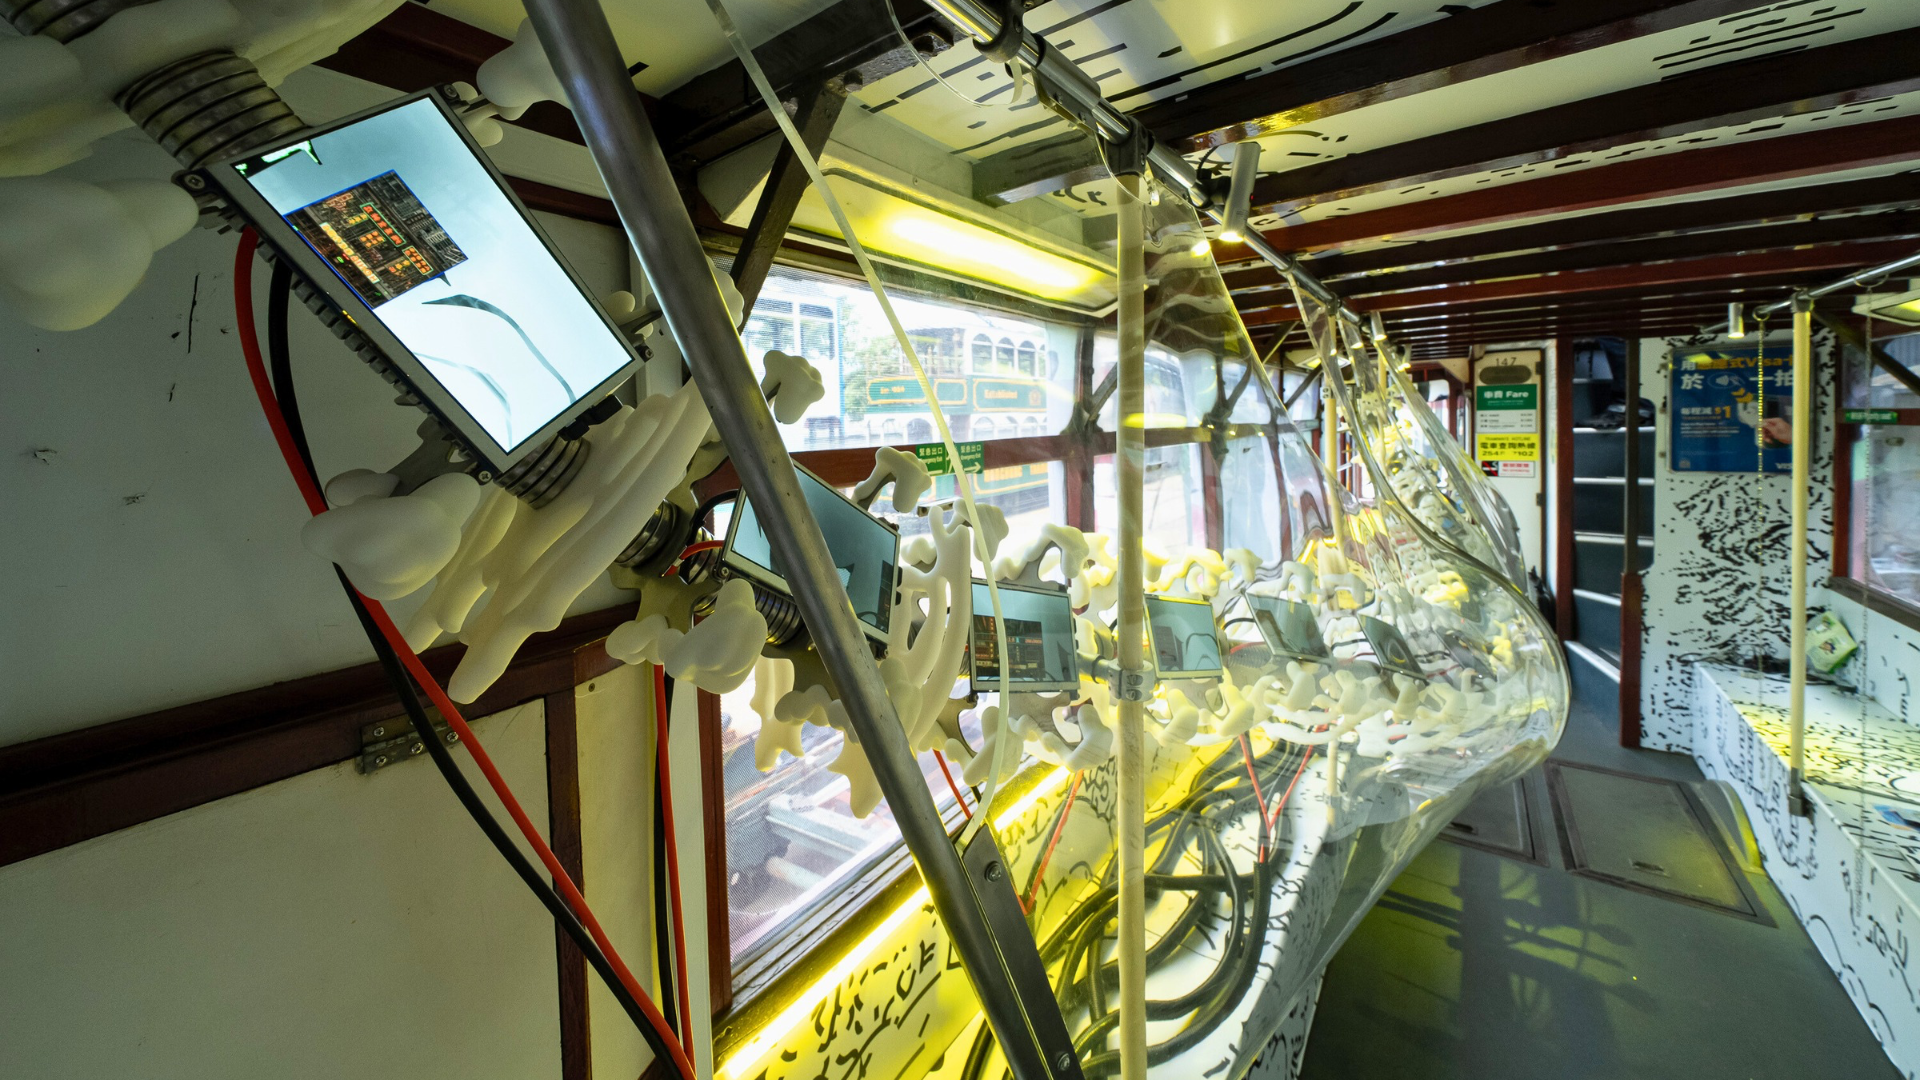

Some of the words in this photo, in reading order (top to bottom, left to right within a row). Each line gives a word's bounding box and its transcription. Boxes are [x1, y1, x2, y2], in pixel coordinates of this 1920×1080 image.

[1680, 373, 1704, 390] 於
[1505, 390, 1529, 399] Fare
[919, 447, 943, 456] 緊急出口
[960, 444, 981, 453] 緊急出口
